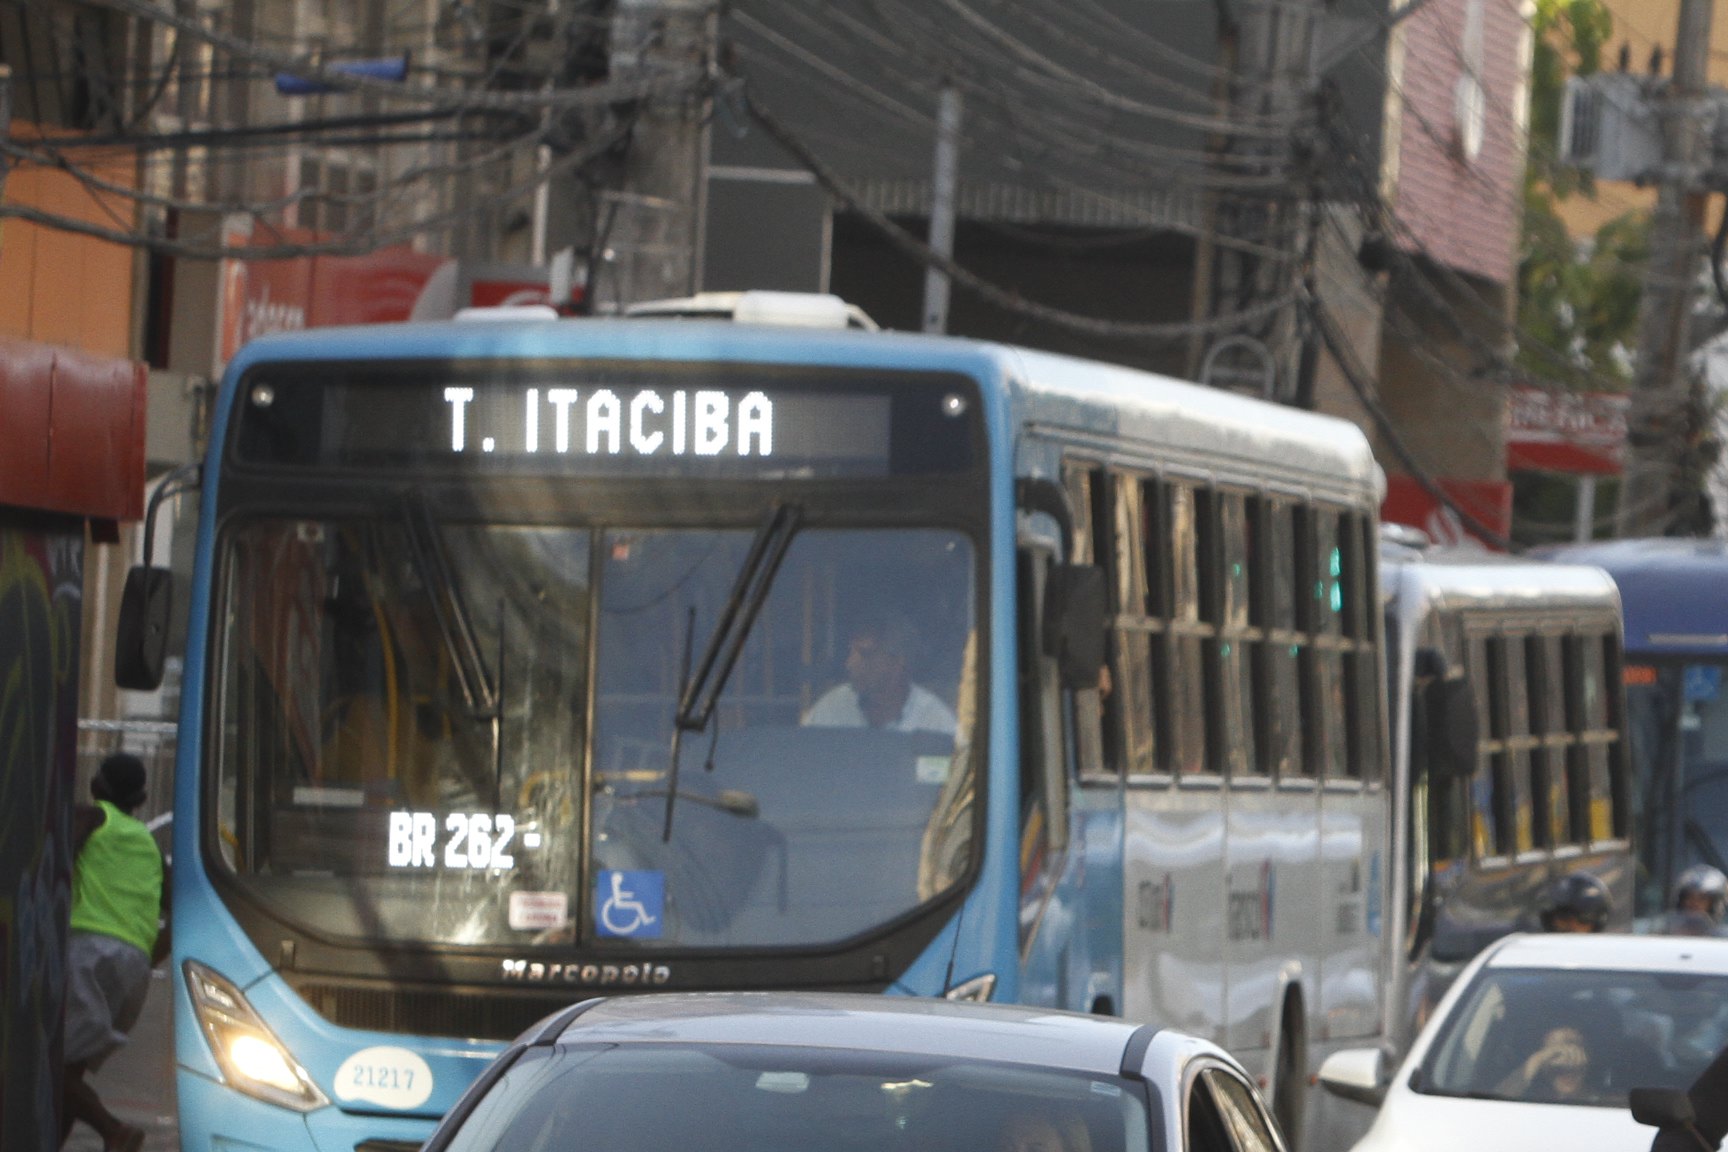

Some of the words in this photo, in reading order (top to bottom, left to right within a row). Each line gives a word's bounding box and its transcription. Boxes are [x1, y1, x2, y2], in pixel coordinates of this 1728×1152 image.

[444, 387, 494, 452] T.
[526, 388, 773, 456] ITACIBA
[389, 811, 435, 868] BR
[502, 958, 671, 984] Marcopolo
[353, 1064, 415, 1091] 21217
